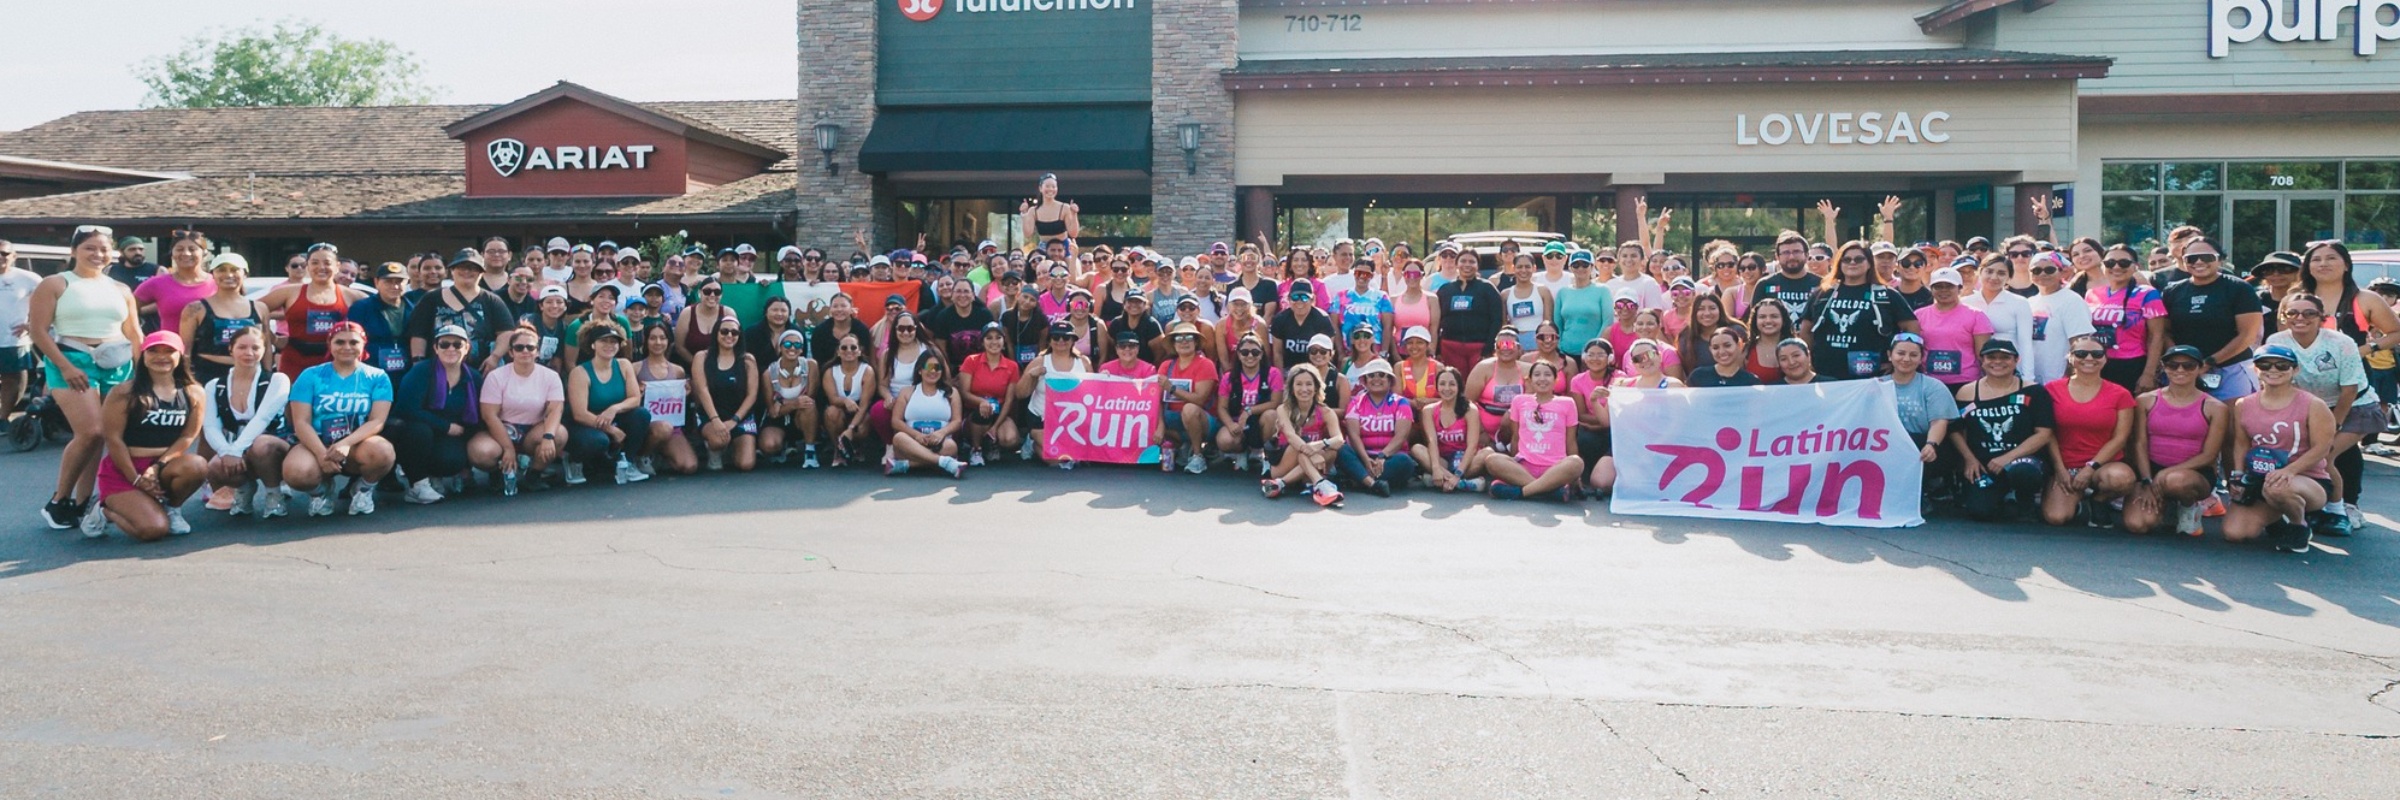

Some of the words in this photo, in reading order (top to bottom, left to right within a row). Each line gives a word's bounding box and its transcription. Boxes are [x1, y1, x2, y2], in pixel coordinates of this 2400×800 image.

[1284, 14, 1361, 32] 710-712
[1737, 111, 1951, 145] LOVESAC
[525, 145, 654, 170] ARIAT
[2270, 175, 2294, 186] 708
[1933, 361, 1952, 370] 5543
[316, 393, 370, 412] Run
[648, 401, 682, 415] Run
[1096, 395, 1152, 411] Latinas
[141, 410, 187, 426] Run
[1050, 402, 1149, 448] Run
[1361, 416, 1395, 432] Run
[1748, 424, 1890, 457] Latinas
[2252, 460, 2276, 471] 5539
[1645, 443, 1886, 520] Run
